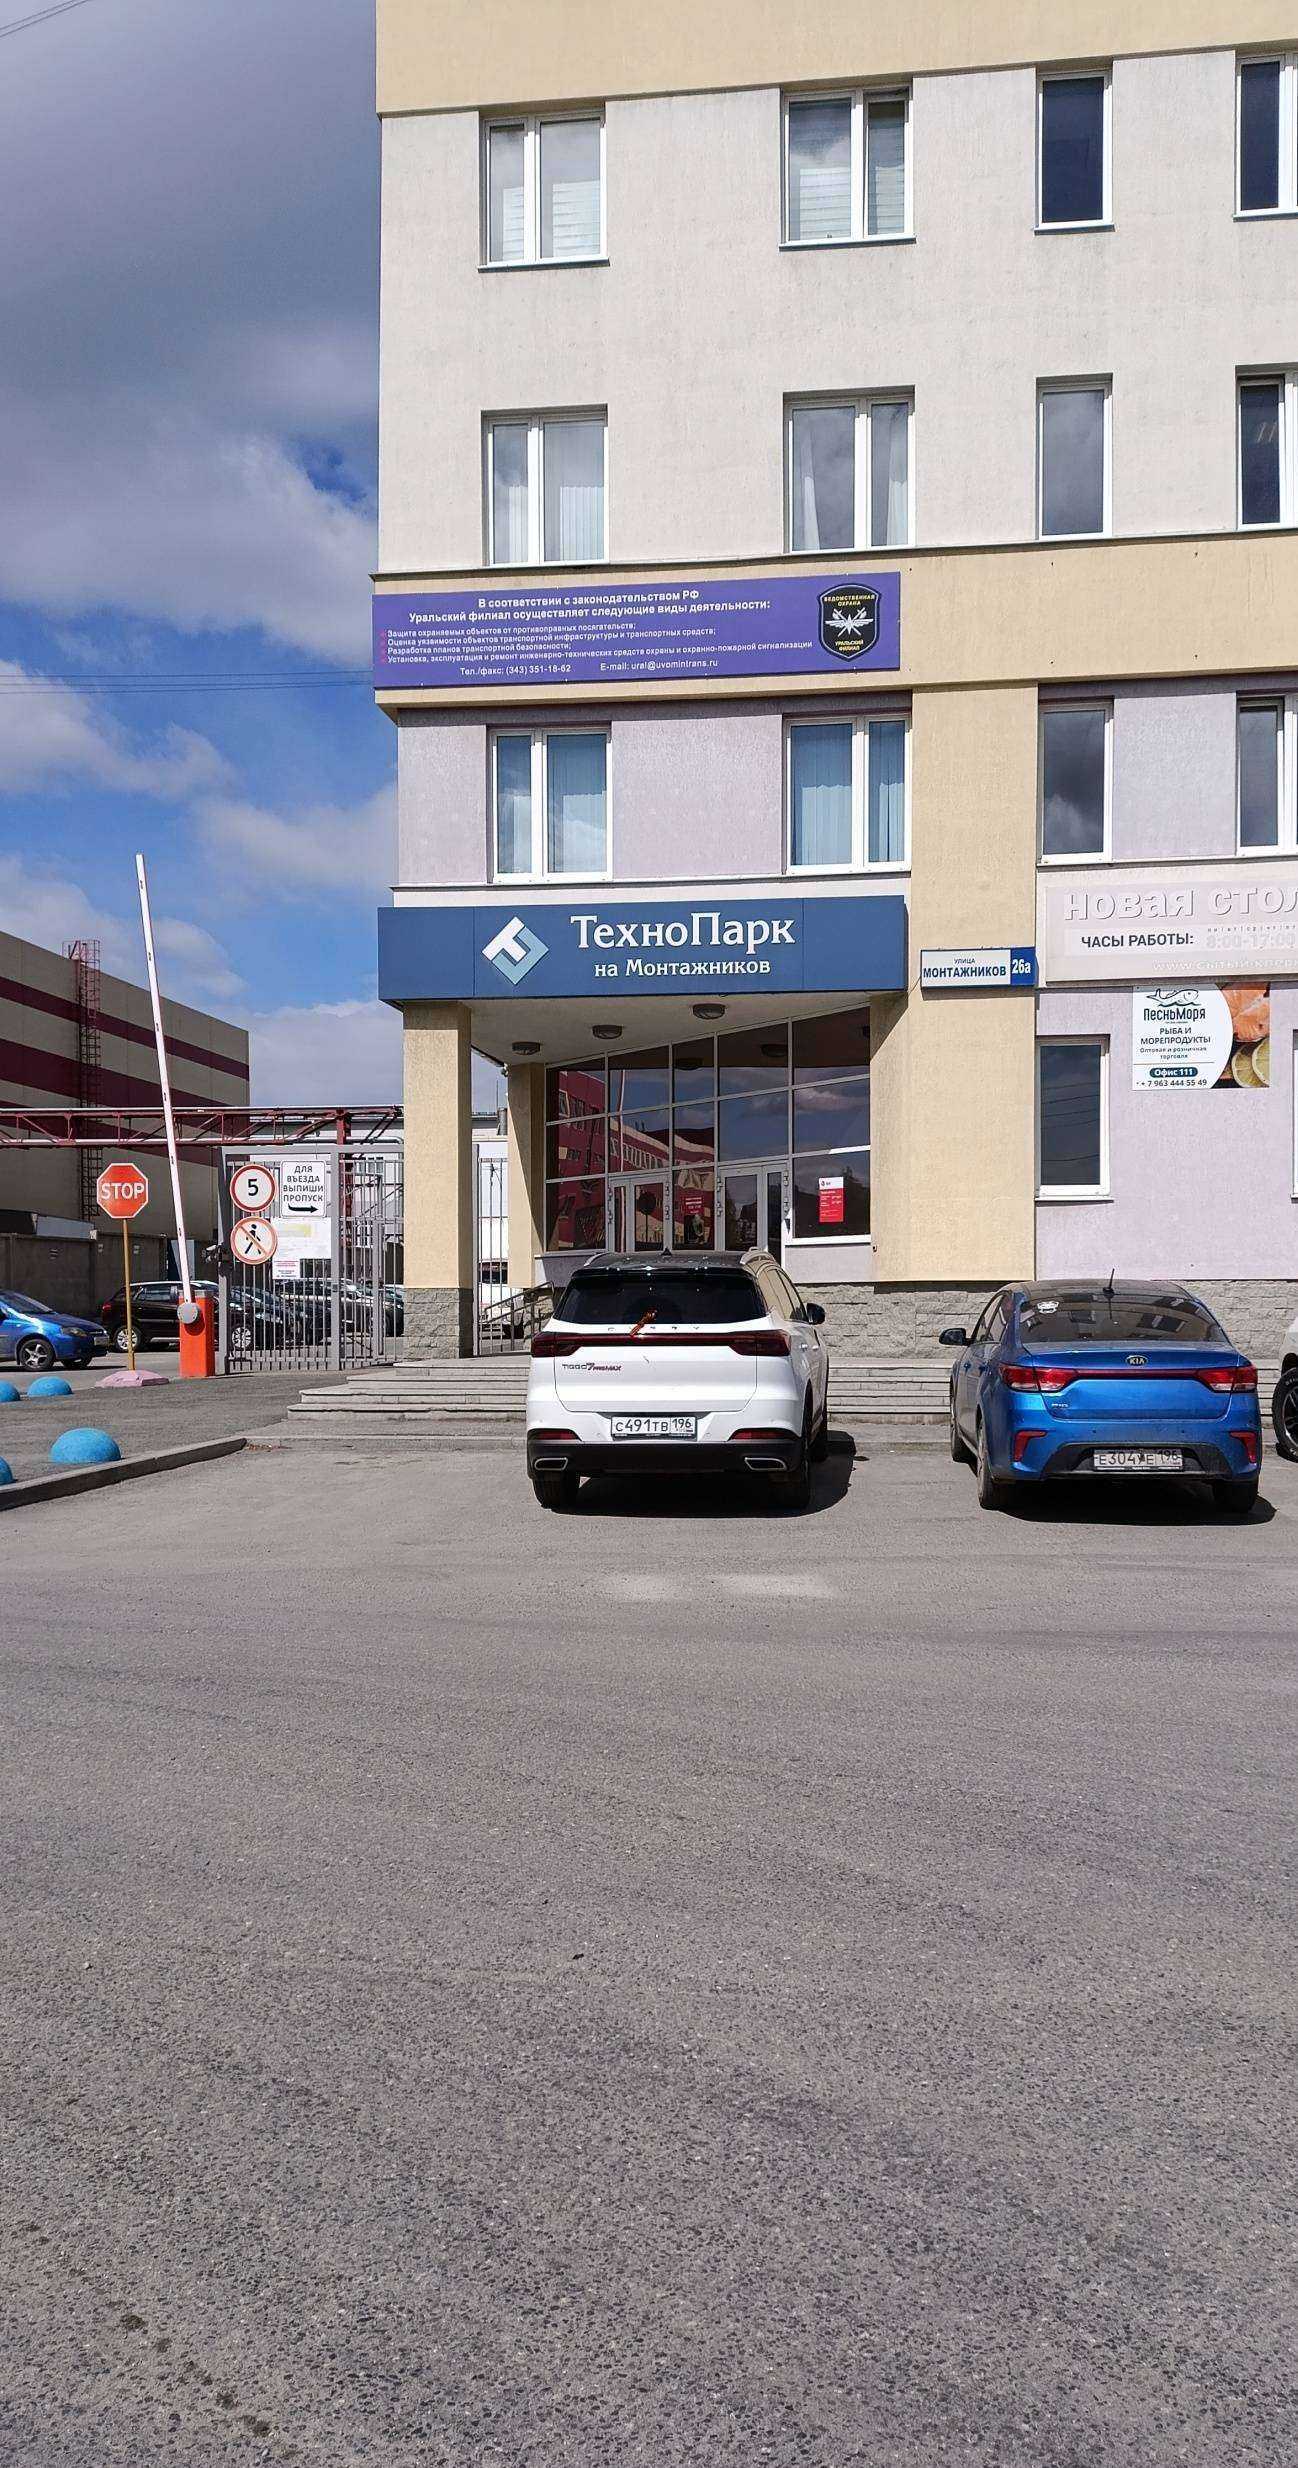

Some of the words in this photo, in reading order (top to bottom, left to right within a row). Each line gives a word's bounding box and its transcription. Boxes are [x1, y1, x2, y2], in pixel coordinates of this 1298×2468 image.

[478, 598, 486, 608] В
[488, 597, 562, 608] соответствии
[563, 597, 570, 605] с
[572, 592, 680, 605] законодательством
[682, 589, 699, 600] РФ
[409, 611, 466, 624] Уральский
[468, 610, 511, 622] филиал
[513, 607, 590, 621] осуществляет
[591, 606, 655, 618] следующие
[657, 603, 688, 613] виды
[689, 600, 771, 613] деятельности:
[387, 629, 417, 638] Защита
[417, 628, 465, 638] охраняемых
[466, 627, 502, 636] объектов
[503, 626, 512, 634] от
[512, 625, 577, 635] противоправных
[387, 638, 416, 647] Оценка
[417, 637, 461, 647] уязвимости
[463, 636, 499, 645] объектов
[500, 634, 553, 644] транспортной
[554, 632, 619, 641] инфраструктуры
[626, 629, 681, 639] транспортных
[387, 645, 432, 656] Разработка
[432, 646, 461, 654] планов
[462, 643, 515, 653] транспортной
[430, 654, 483, 664] эксплуатация
[490, 653, 518, 661] ремонт
[613, 649, 645, 657] средств
[645, 647, 675, 656] охраны
[757, 640, 813, 650] сигнализации
[505, 665, 528, 675] (343)
[529, 664, 572, 674] 351-18-62
[600, 662, 630, 671] E-mail:
[570, 911, 796, 955] ТехноПарк
[1081, 934, 1124, 948] ЧАСЫ
[1128, 932, 1194, 947] РАБОТЫ:
[594, 964, 618, 977] на
[625, 958, 771, 977] Монтажников
[923, 965, 1007, 978] МОНТАЖНИКОВ
[1011, 958, 1031, 974] 26а
[1143, 1007, 1206, 1022] ПесньМоря
[1159, 1027, 1183, 1035] РЫБА
[1140, 1036, 1211, 1045] МОРЕПРОДУКТЫ
[1154, 1068, 1178, 1077] Офис
[1179, 1068, 1193, 1076] 111
[1197, 1078, 1207, 1086] 49
[294, 1165, 313, 1174] ДЛЯ
[286, 1175, 320, 1184] ВЪЕЗДА
[101, 1182, 145, 1200] STOP
[247, 1178, 259, 1196] 5
[283, 1184, 324, 1193] ВЫПИШИ
[283, 1194, 323, 1203] ПРОПУСК
[1129, 1357, 1145, 1365] KIA
